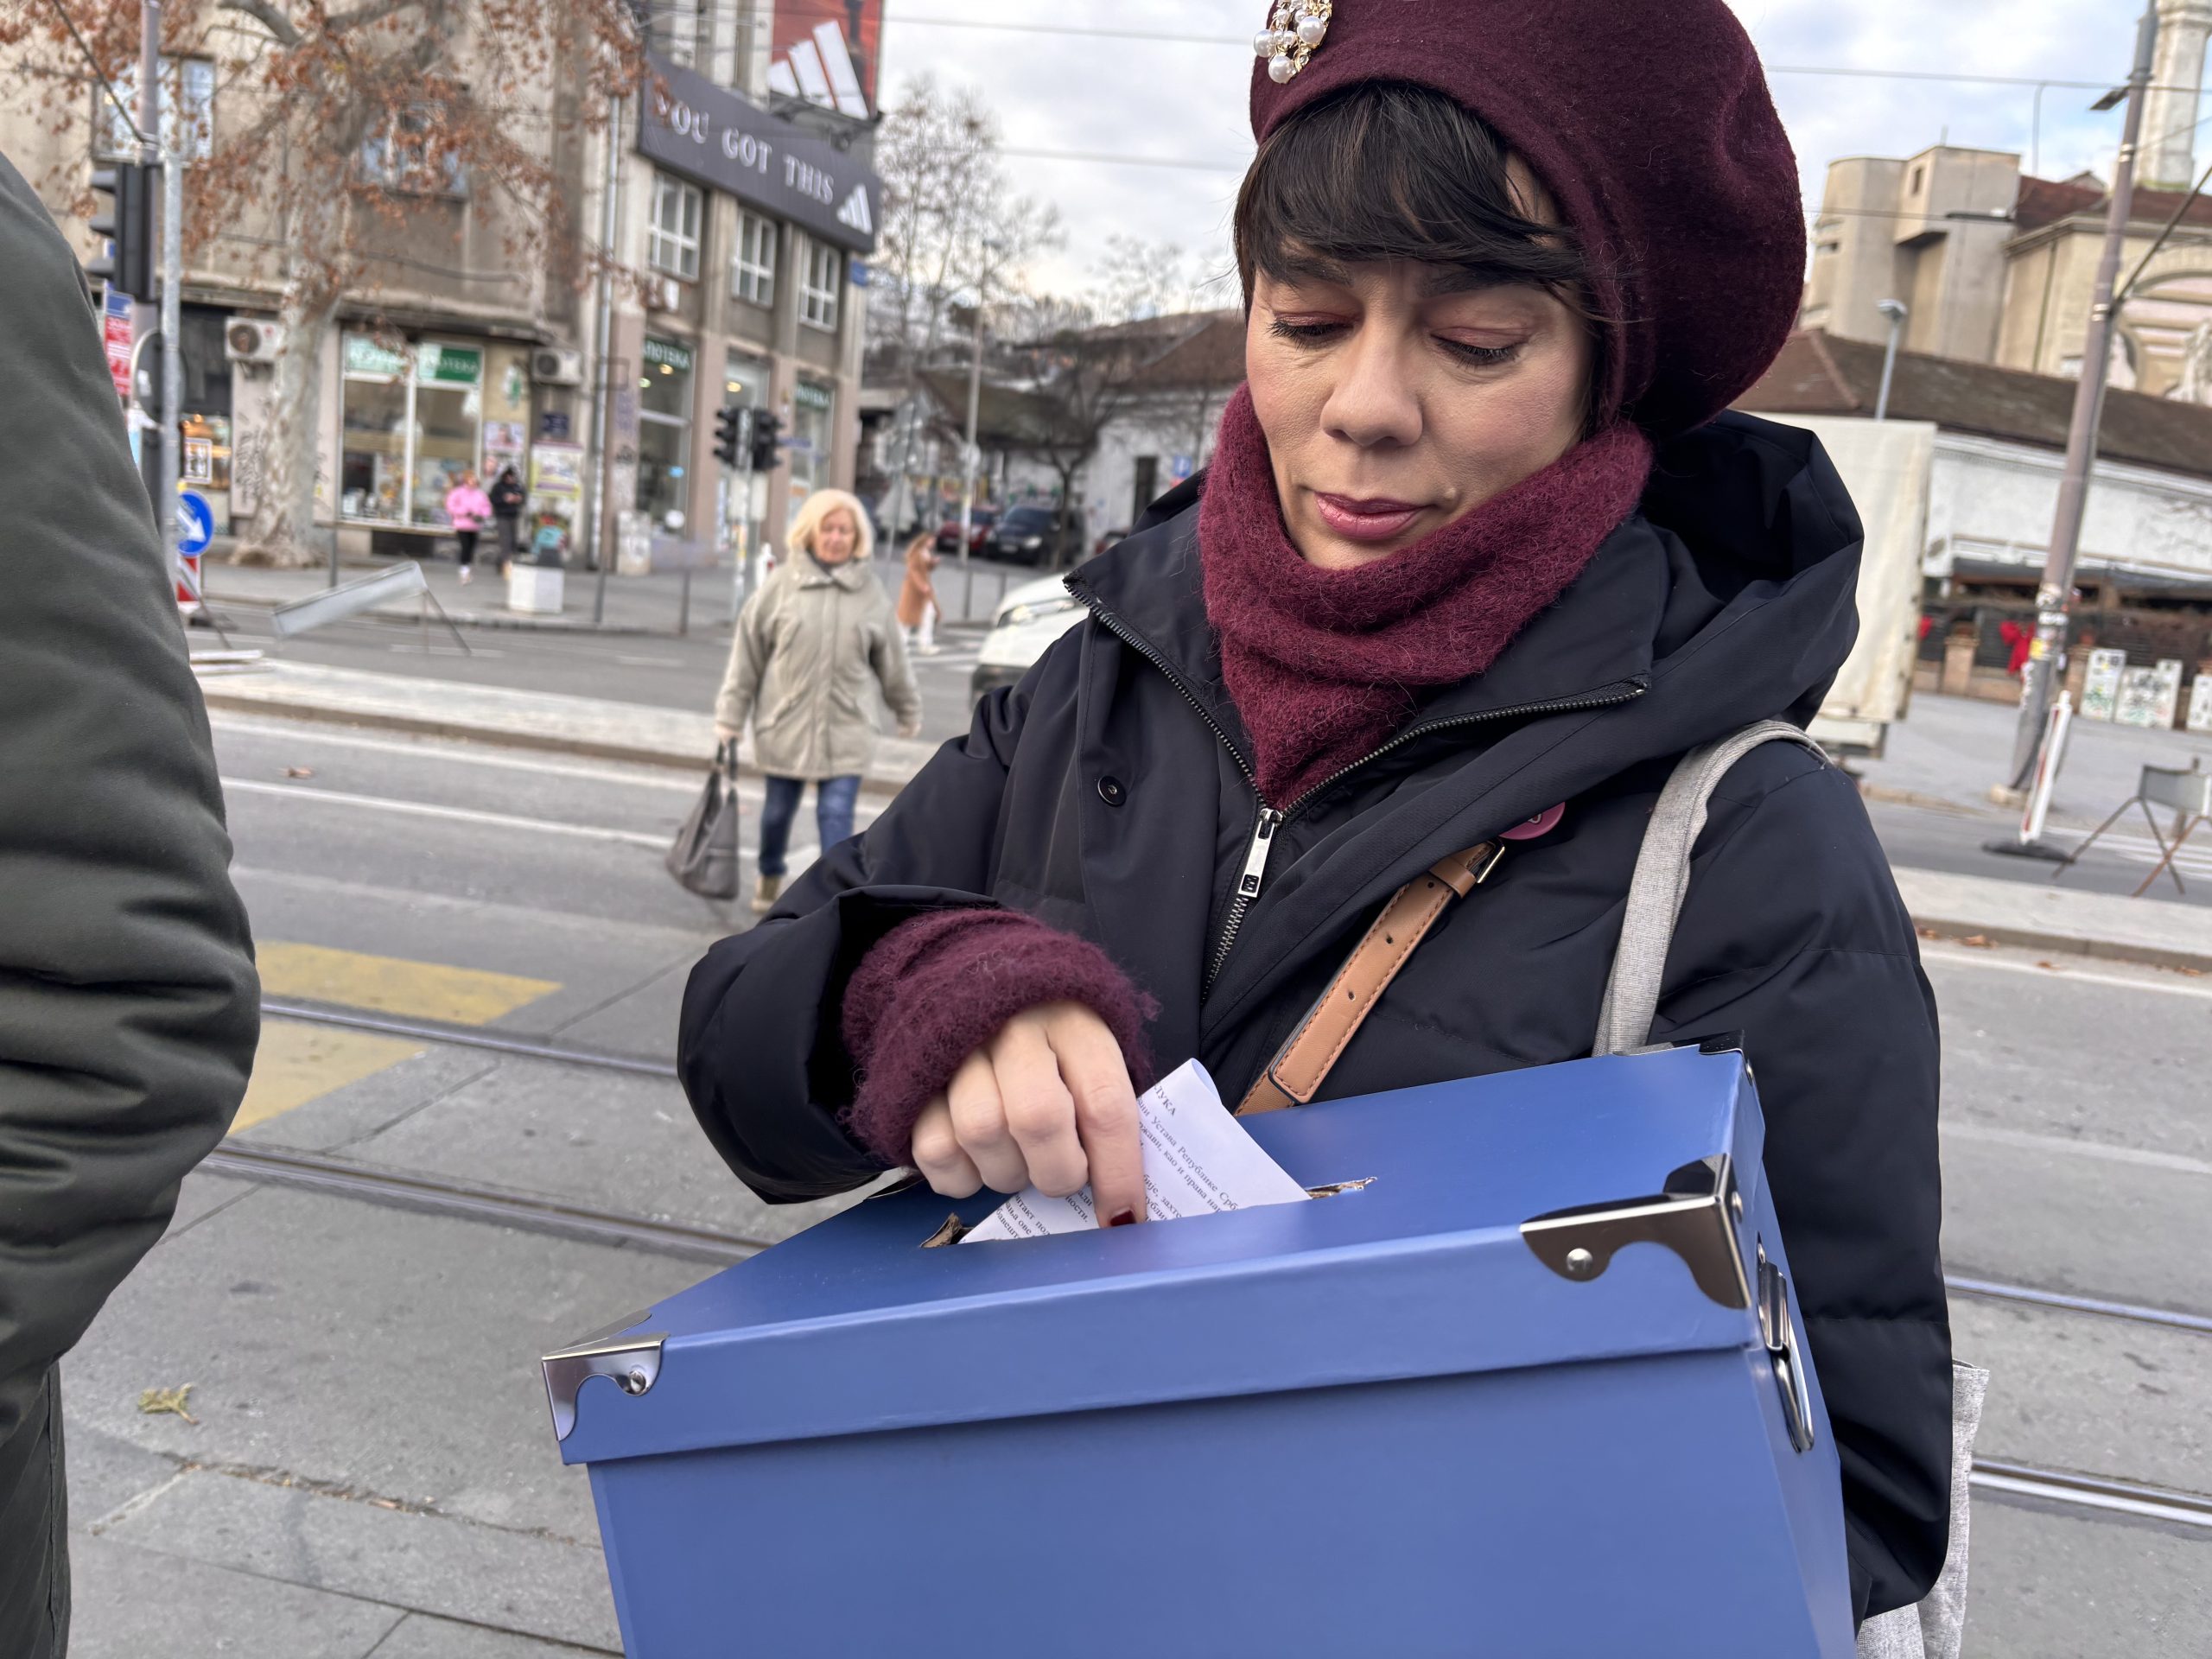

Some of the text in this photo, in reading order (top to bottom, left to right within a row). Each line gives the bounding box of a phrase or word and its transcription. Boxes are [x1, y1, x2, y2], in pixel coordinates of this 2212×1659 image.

[721, 126, 772, 174] GOT
[783, 153, 834, 206] THIS
[1154, 1084, 1176, 1116] ЛУКА
[1151, 1116, 1177, 1147] Устава
[1178, 1147, 1218, 1192] Републике
[1219, 1192, 1239, 1211] Срб
[1164, 1150, 1178, 1167] као
[1185, 1174, 1207, 1199] права
[1019, 1220, 1032, 1235] ове
